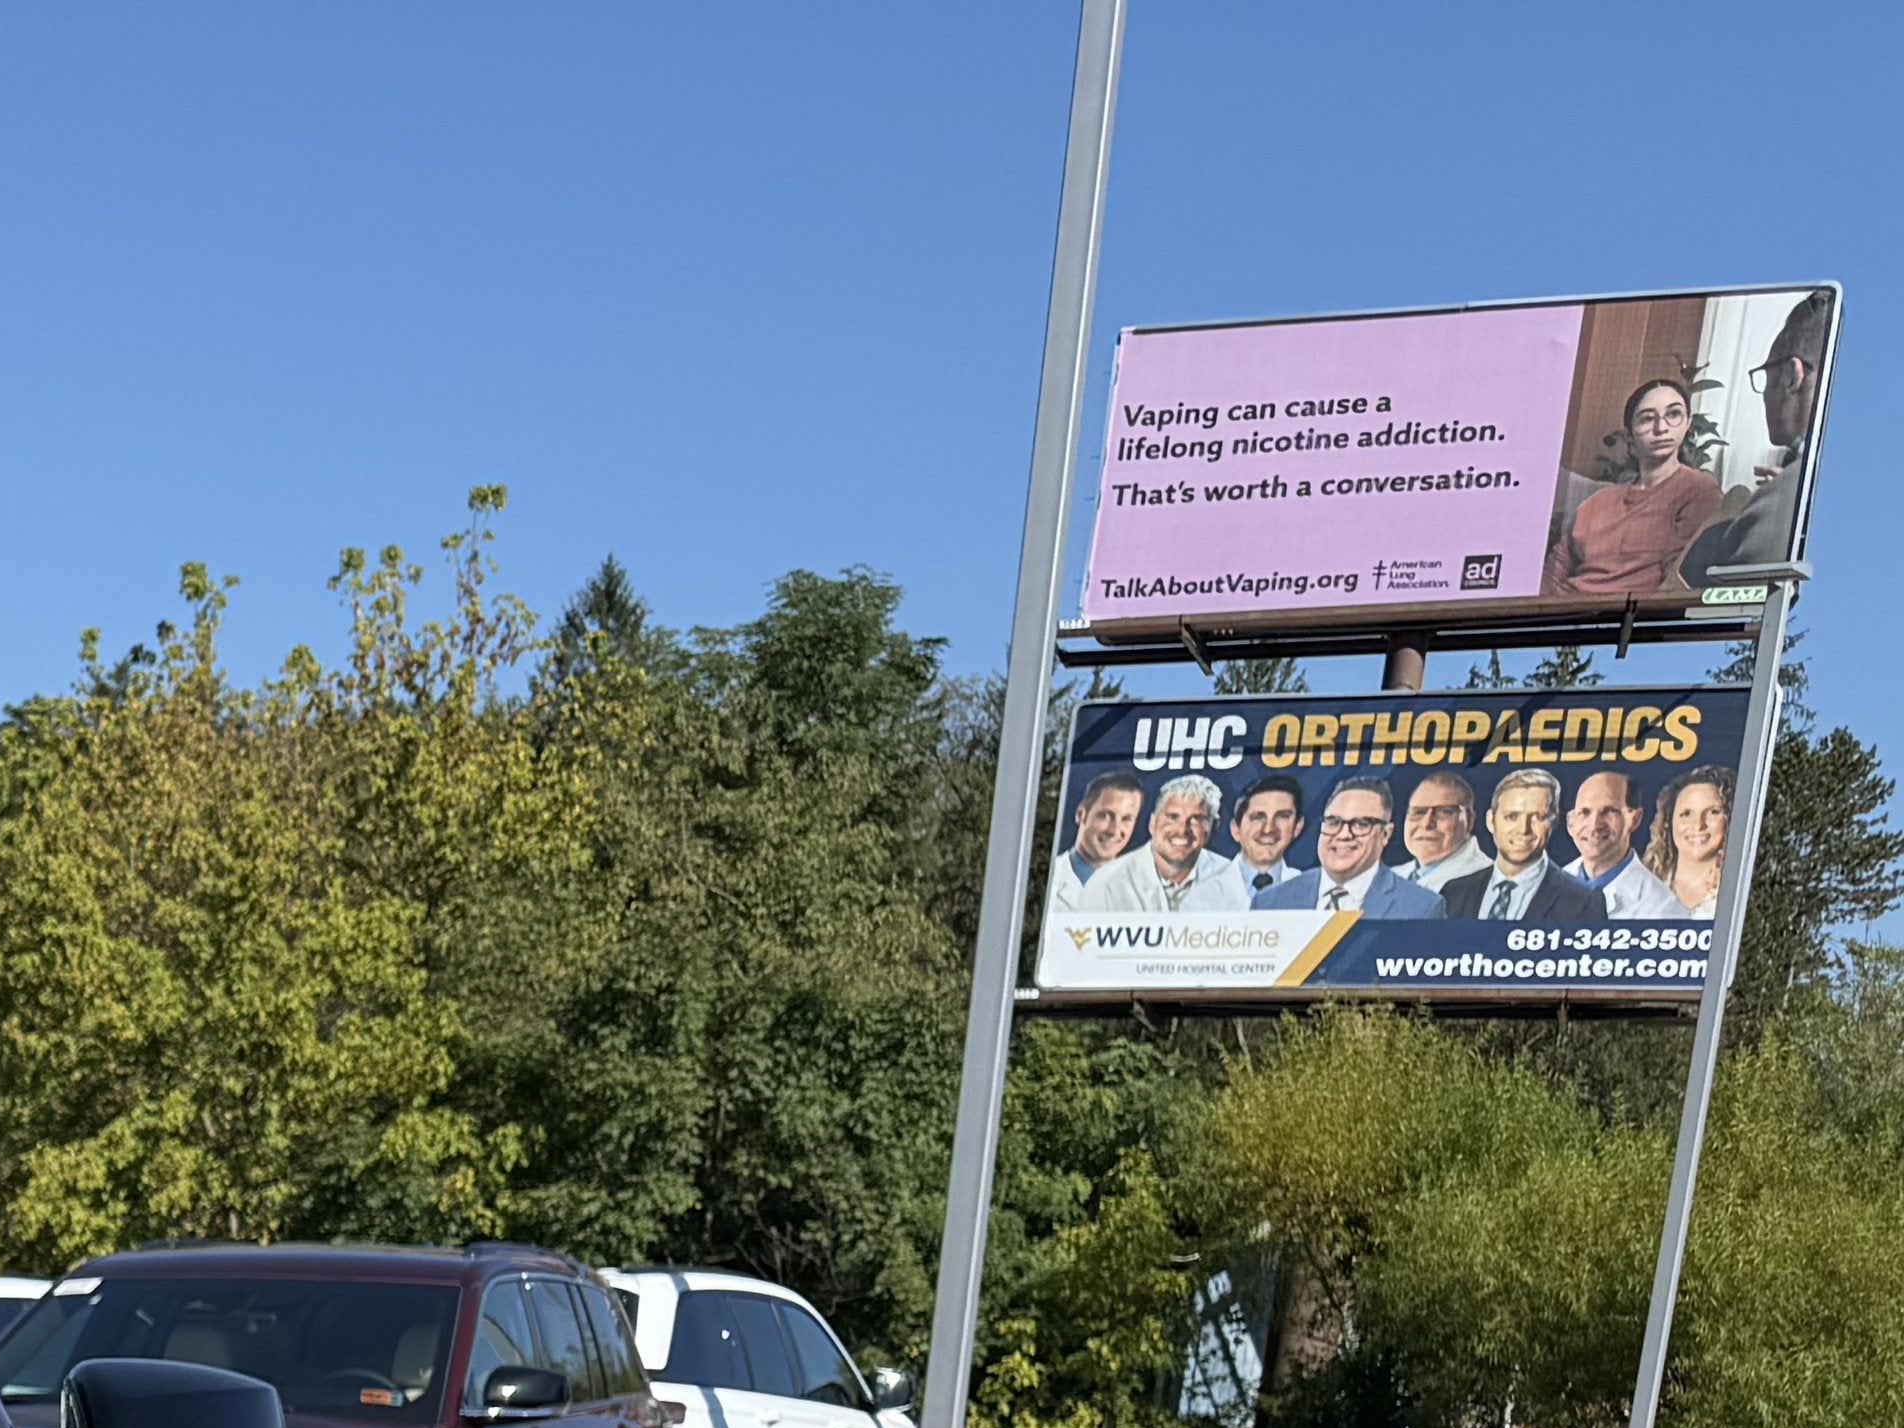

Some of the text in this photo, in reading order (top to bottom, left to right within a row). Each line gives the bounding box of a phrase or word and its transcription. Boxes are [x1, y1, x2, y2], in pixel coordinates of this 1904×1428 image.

[1124, 396, 1392, 431] Vaping can cause a
[1117, 421, 1505, 462] lifelong nicotine addiction.
[1112, 467, 1520, 506] That's worth a conversation.
[1389, 571, 1416, 580] Lung
[1390, 560, 1442, 569] American
[1464, 556, 1498, 580] ad
[1101, 572, 1358, 598] TalkAboutVaping.org
[1387, 580, 1449, 589] Association
[1132, 705, 1702, 771] UHC ORTHOPAEDICS
[1507, 929, 1713, 951] 681-342-3500
[1376, 953, 1708, 978] wvorthocenter.com
